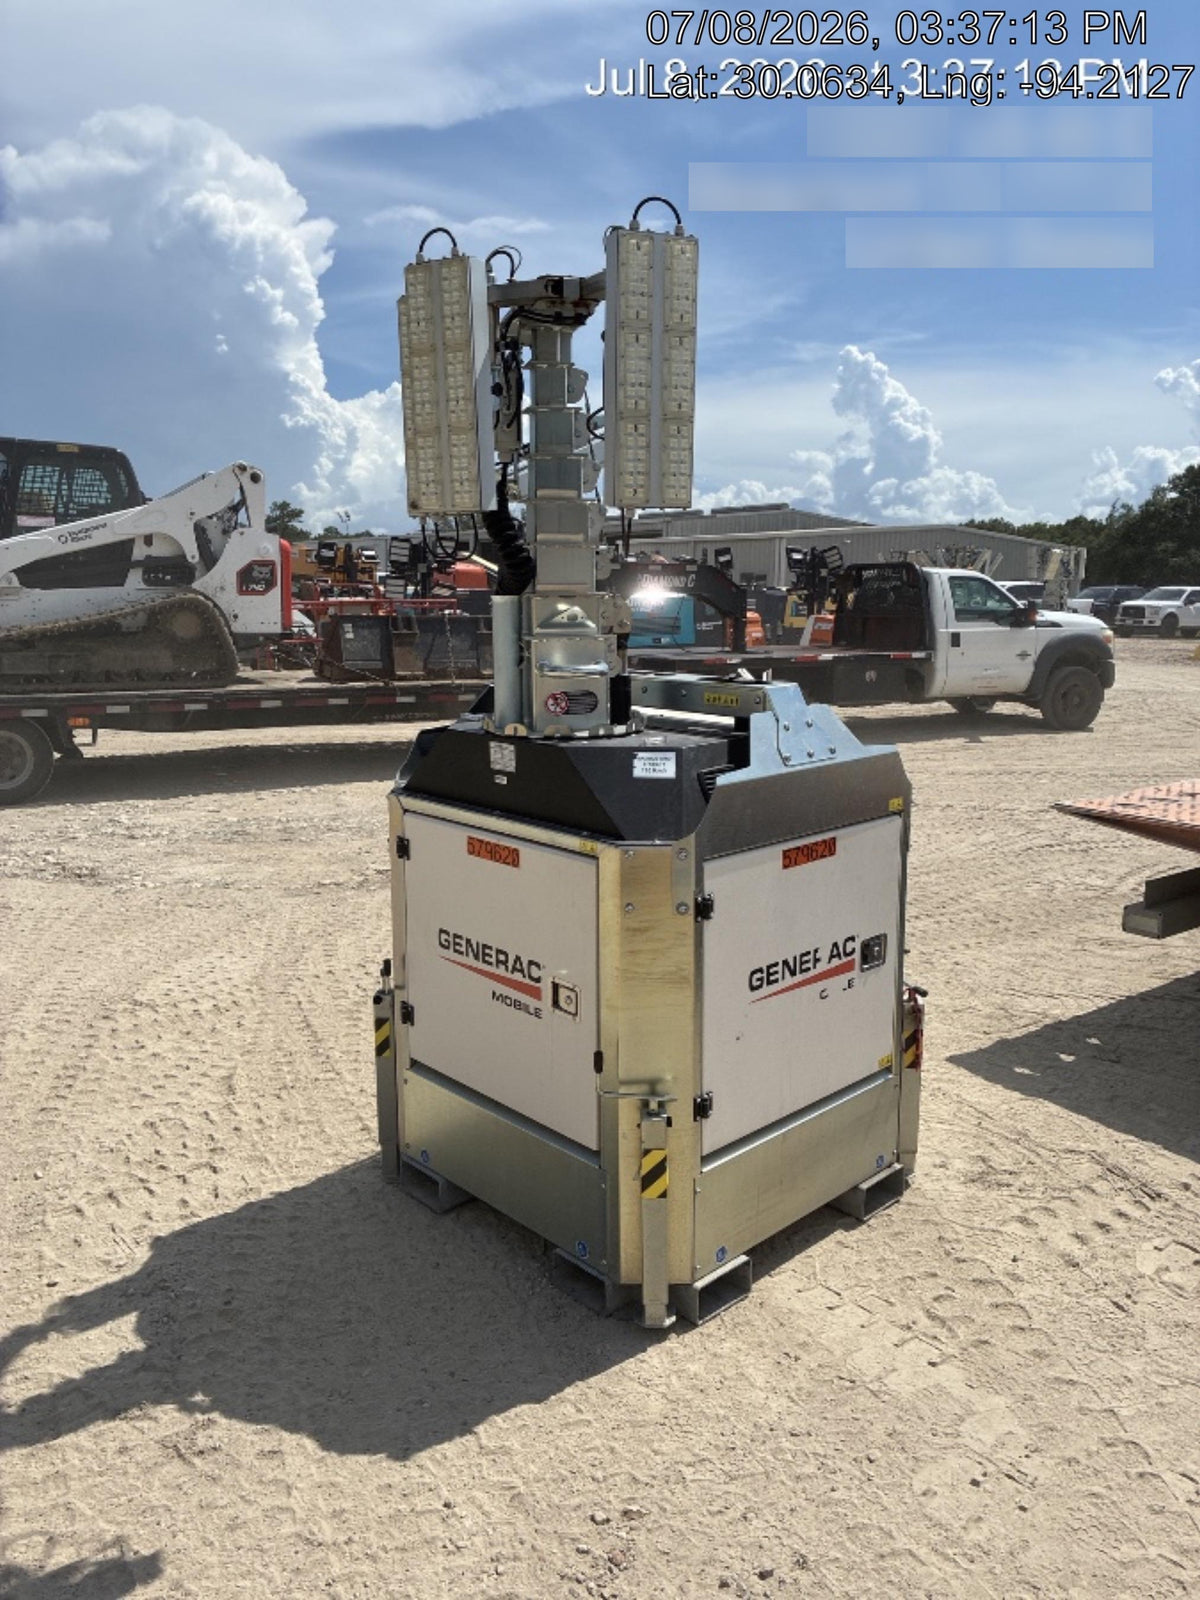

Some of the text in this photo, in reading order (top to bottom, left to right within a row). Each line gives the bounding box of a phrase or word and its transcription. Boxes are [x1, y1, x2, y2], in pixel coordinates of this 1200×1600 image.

[467, 836, 520, 868] 579620
[782, 837, 836, 869] 579620
[438, 927, 542, 984] GENERAC
[491, 990, 543, 1019] MOBILE
